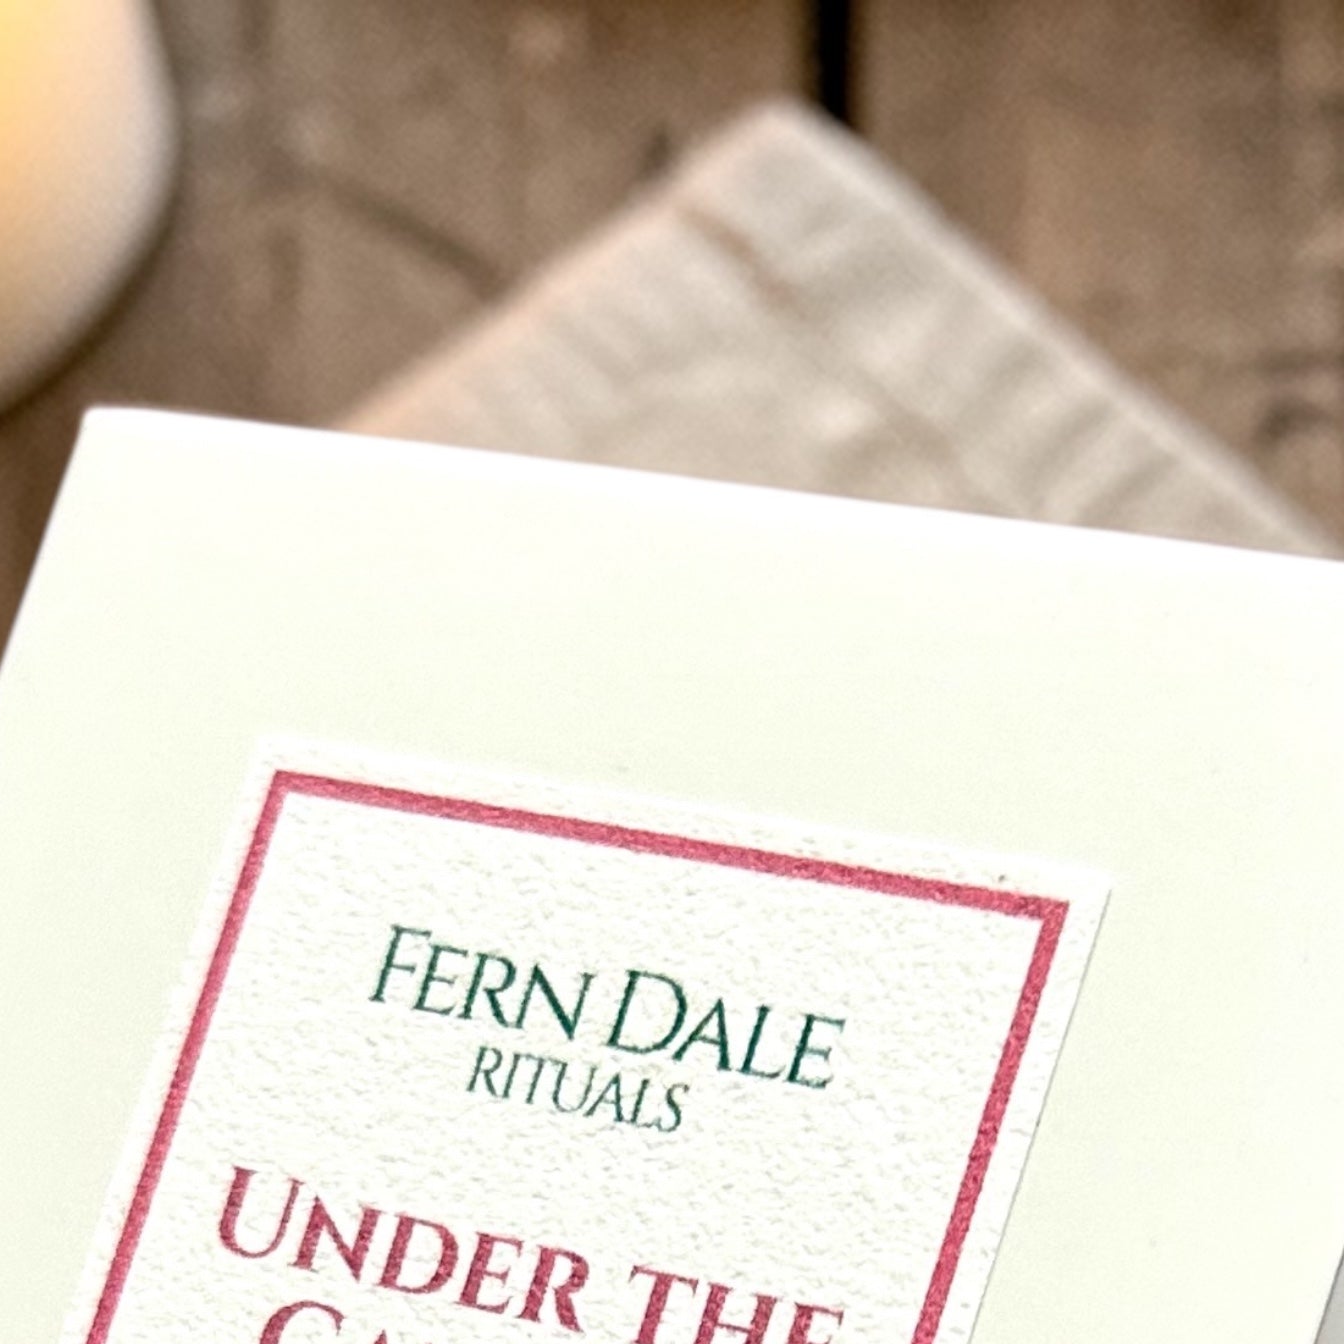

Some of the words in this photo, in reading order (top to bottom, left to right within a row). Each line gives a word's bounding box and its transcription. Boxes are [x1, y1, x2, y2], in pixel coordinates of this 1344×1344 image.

[368, 924, 592, 1041] FERN
[606, 969, 846, 1091] DALE
[467, 1046, 689, 1133] RITUALS
[217, 1166, 589, 1333] UNDER
